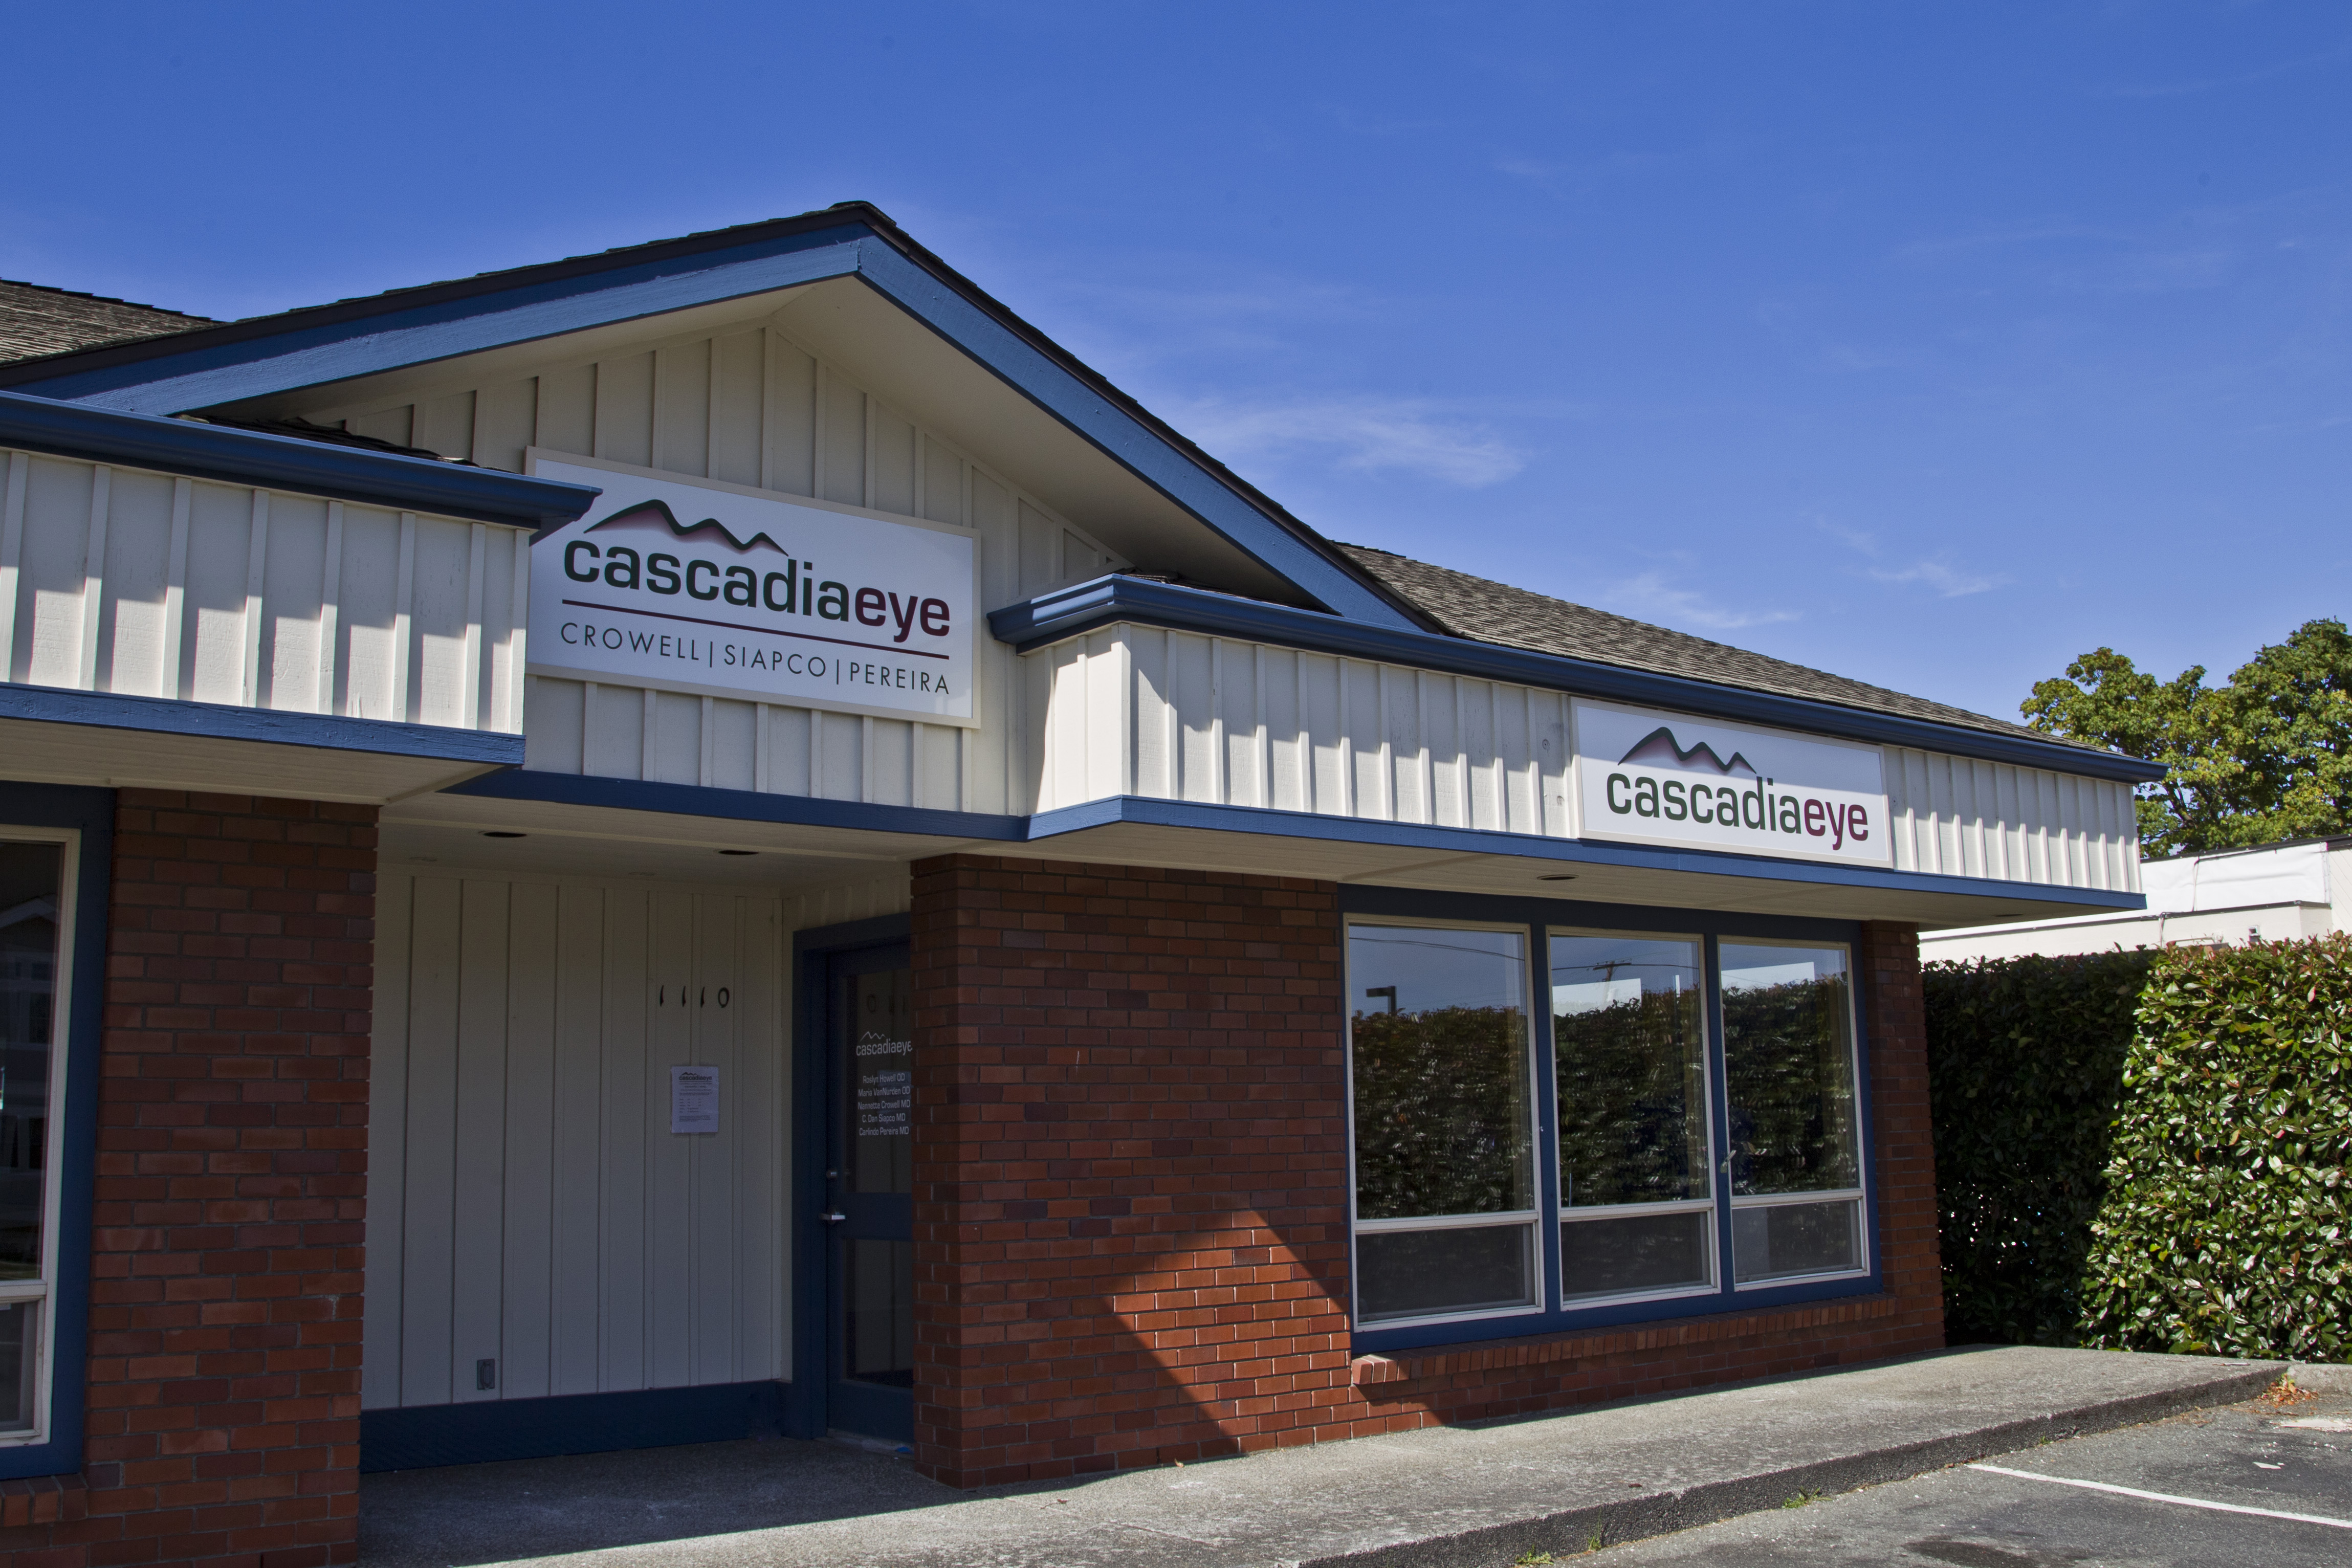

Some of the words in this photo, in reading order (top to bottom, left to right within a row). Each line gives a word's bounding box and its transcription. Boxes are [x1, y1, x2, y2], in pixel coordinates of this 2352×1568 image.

[564, 540, 951, 643] cascadiaeye
[561, 622, 700, 661] CROWELL
[723, 644, 827, 678] SIAPCO
[849, 662, 950, 695] PEREIRA
[1607, 772, 1869, 851] cascadiaeye
[659, 985, 730, 1008] 1110
[856, 1038, 913, 1056] cascadiaeye
[863, 1075, 878, 1085] Roslyn
[880, 1073, 896, 1083] Howell
[897, 1073, 905, 1081] OD
[858, 1088, 872, 1097] Maria
[902, 1086, 910, 1095] OD
[858, 1102, 881, 1110] Nannette
[881, 1100, 900, 1109] Crowell
[901, 1099, 911, 1108] MD
[862, 1114, 867, 1123] C.
[868, 1114, 877, 1122] Dan
[878, 1113, 895, 1124] Siapco
[896, 1113, 906, 1121] MD
[880, 1127, 898, 1135] Pereira
[899, 1126, 909, 1135] MD
